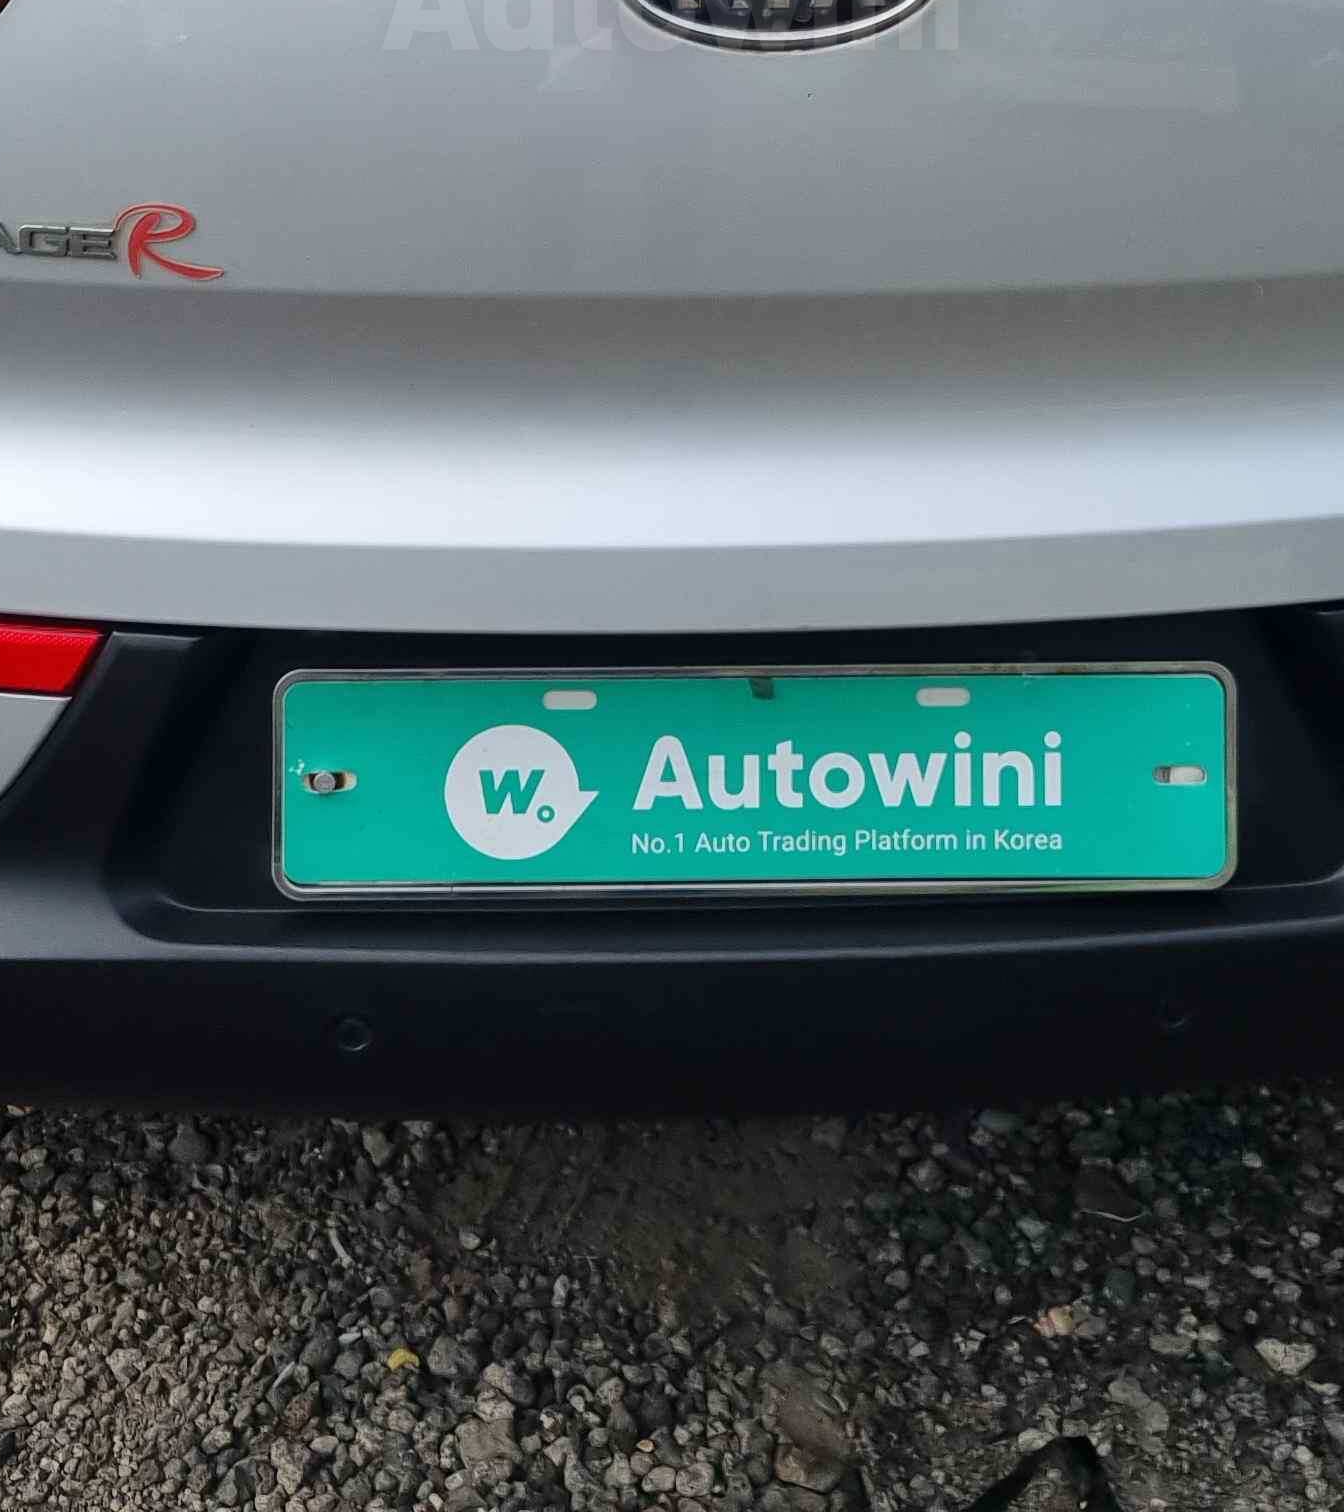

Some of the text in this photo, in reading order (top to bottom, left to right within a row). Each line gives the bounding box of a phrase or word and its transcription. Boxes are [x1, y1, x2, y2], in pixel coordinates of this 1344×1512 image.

[632, 731, 1062, 810] Autowini
[631, 828, 1063, 856] No.1 Auto Trading Platform in Korea
